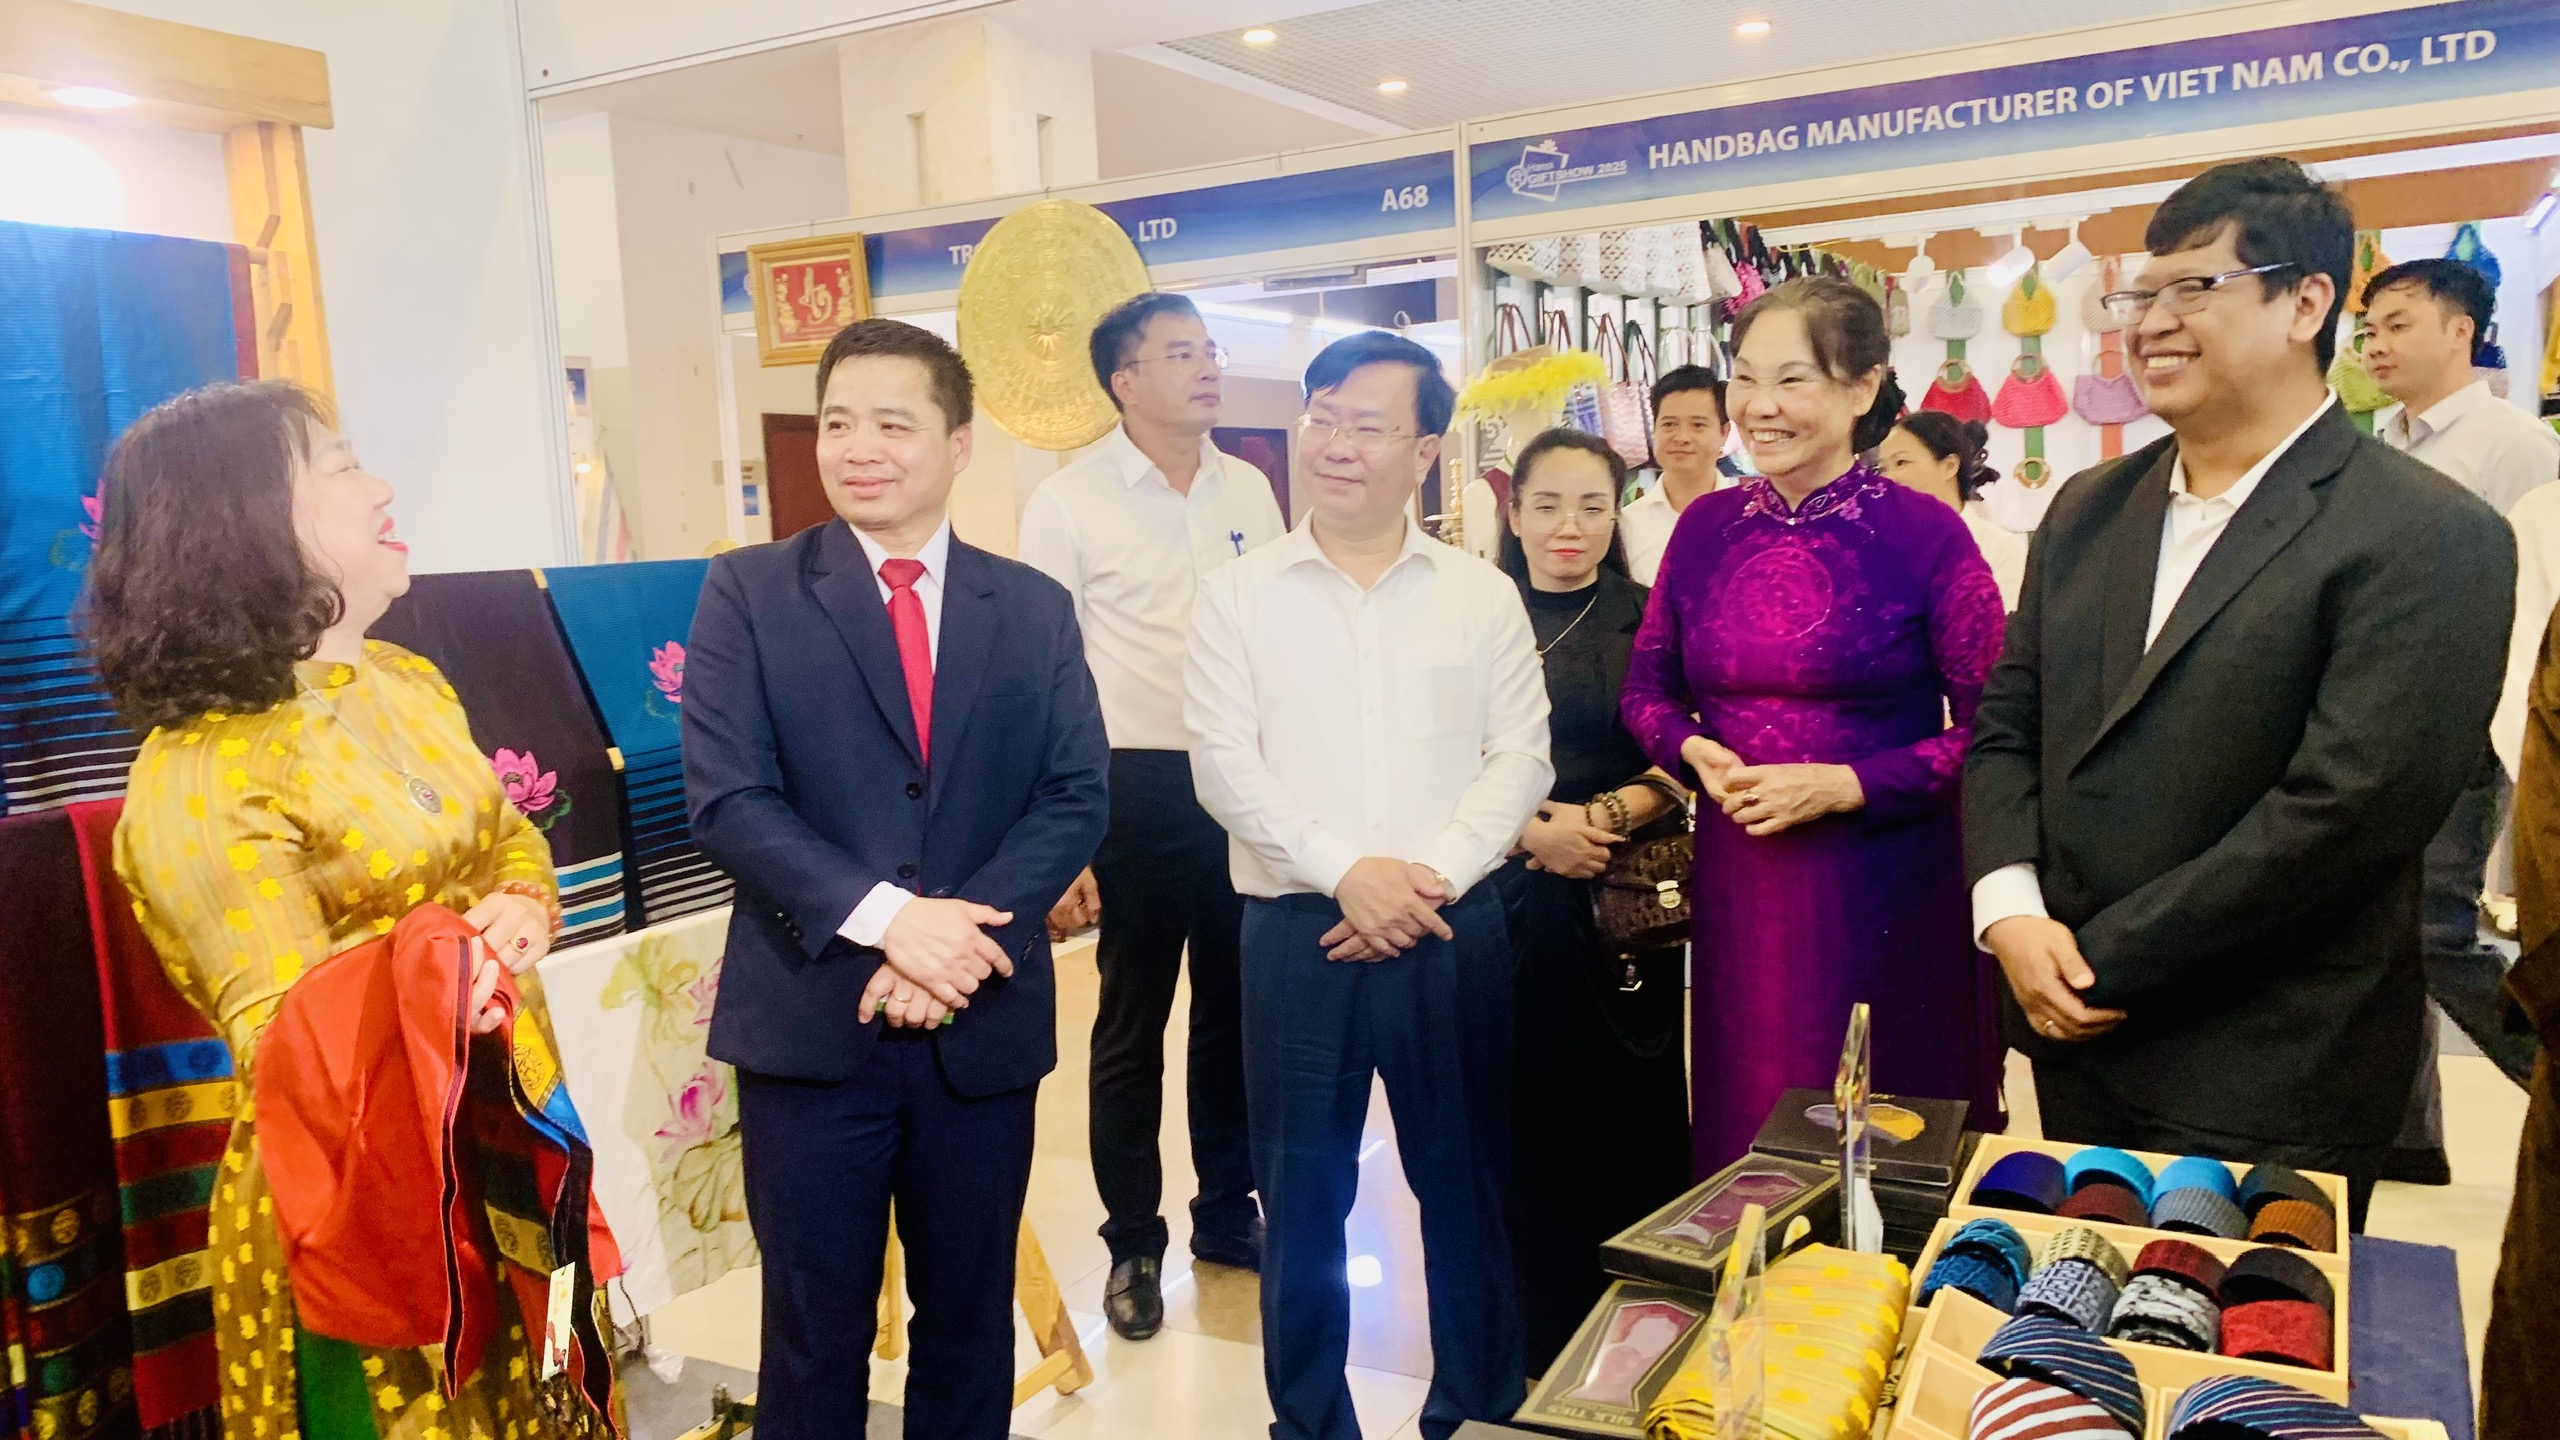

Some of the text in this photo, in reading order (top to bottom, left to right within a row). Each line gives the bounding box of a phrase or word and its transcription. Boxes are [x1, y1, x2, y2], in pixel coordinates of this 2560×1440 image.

[1649, 29, 2497, 170] HANDBAG MANUFACTURER OF VIET NAM CO., LTD
[1598, 160, 1628, 174] 2025
[1381, 184, 1430, 212] A68
[1138, 217, 1178, 242] LTD
